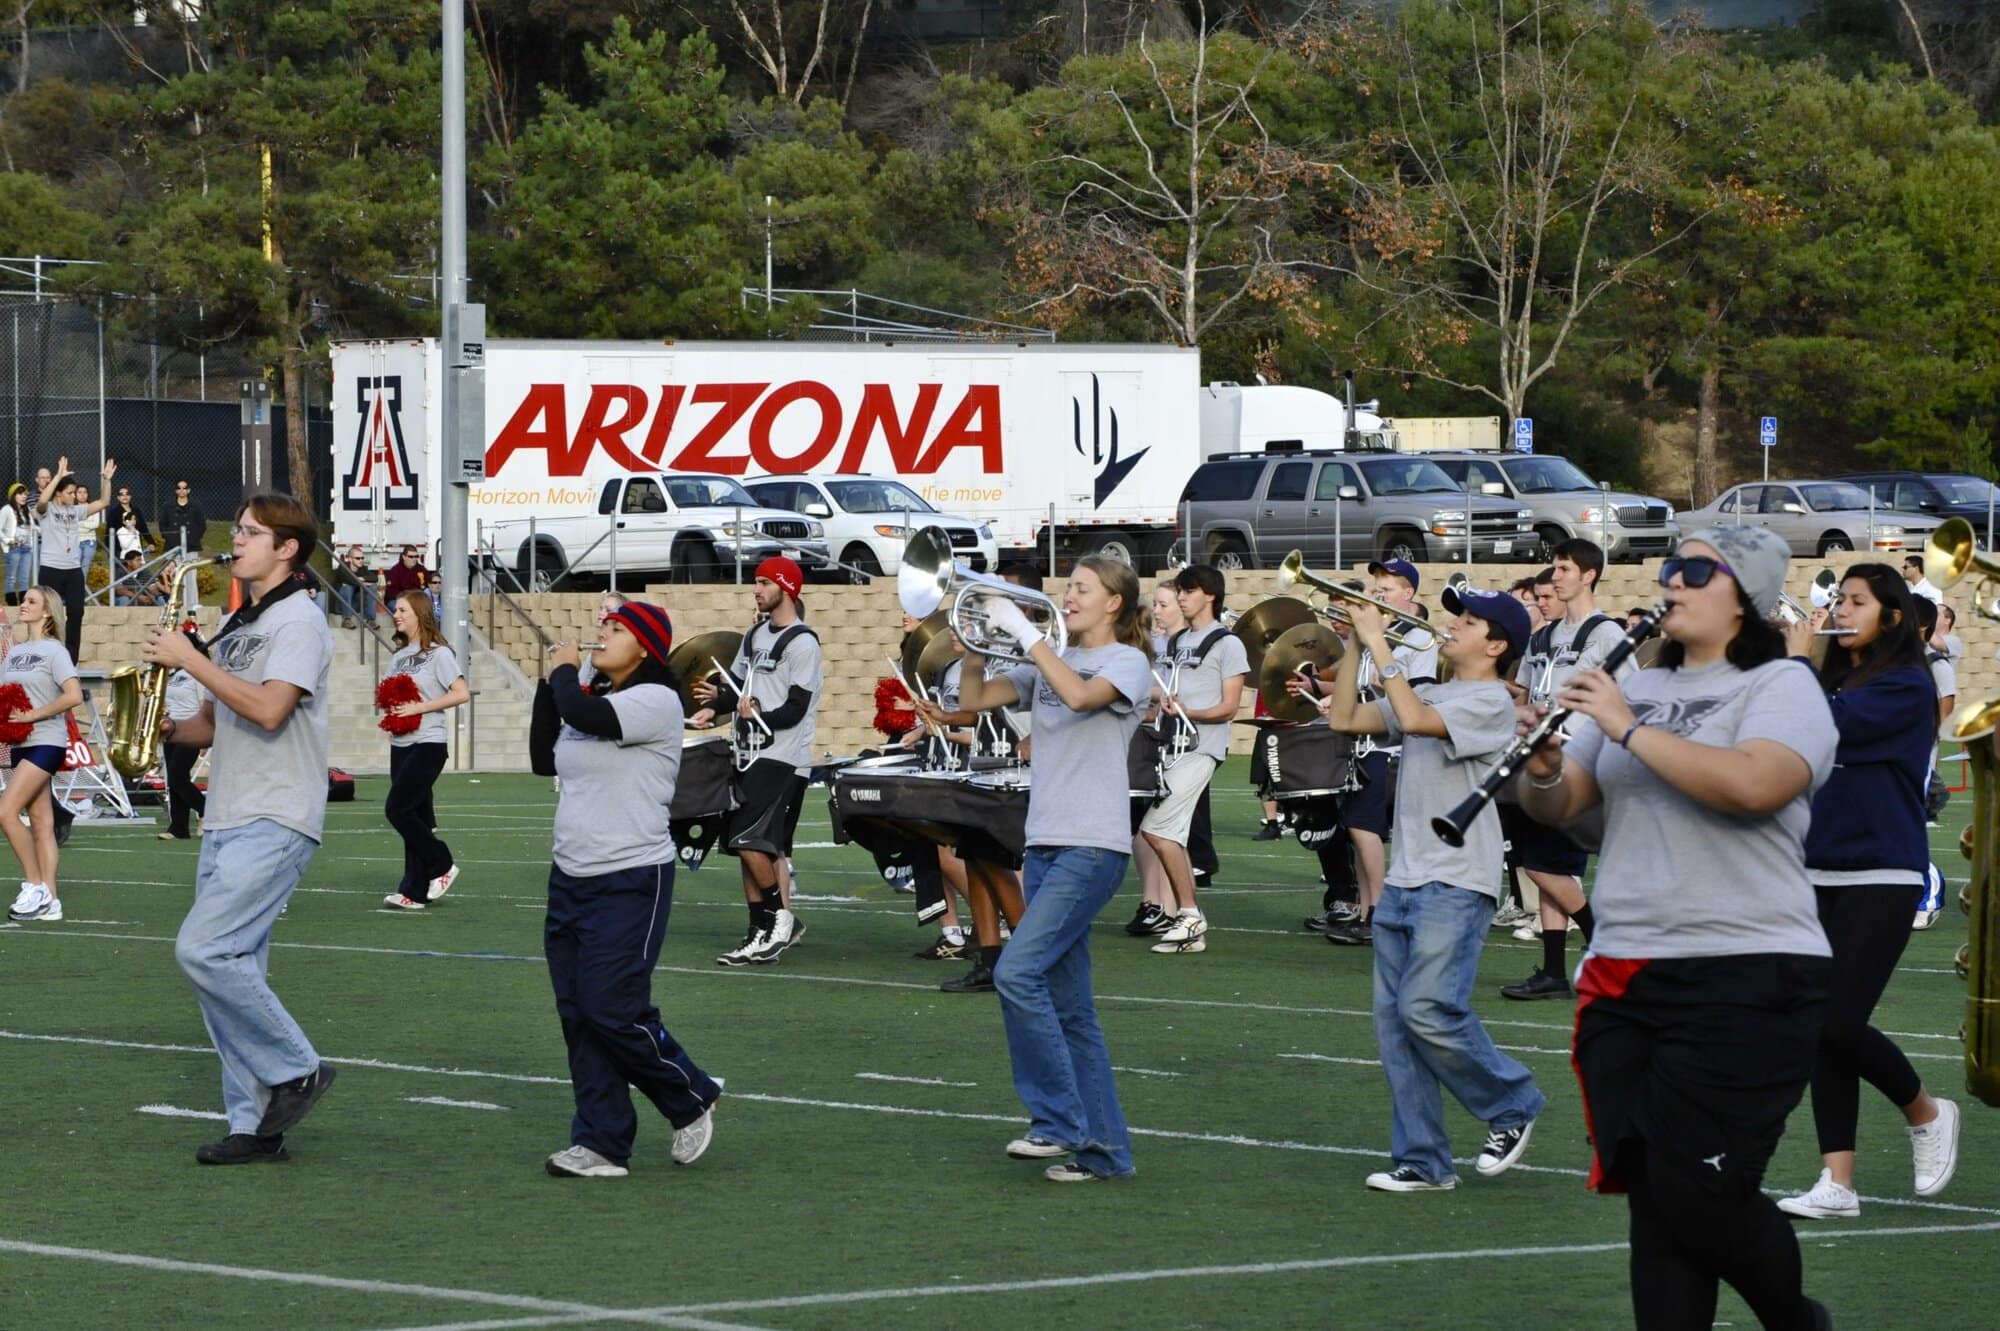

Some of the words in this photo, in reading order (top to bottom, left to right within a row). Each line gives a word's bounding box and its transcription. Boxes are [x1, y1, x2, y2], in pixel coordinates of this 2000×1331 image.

[343, 376, 419, 511] A
[485, 380, 1004, 478] ARIZONA
[468, 487, 541, 505] Horizon
[954, 487, 1002, 502] move
[1267, 746, 1281, 783] YAMAHA
[857, 789, 881, 801] YAMAHA
